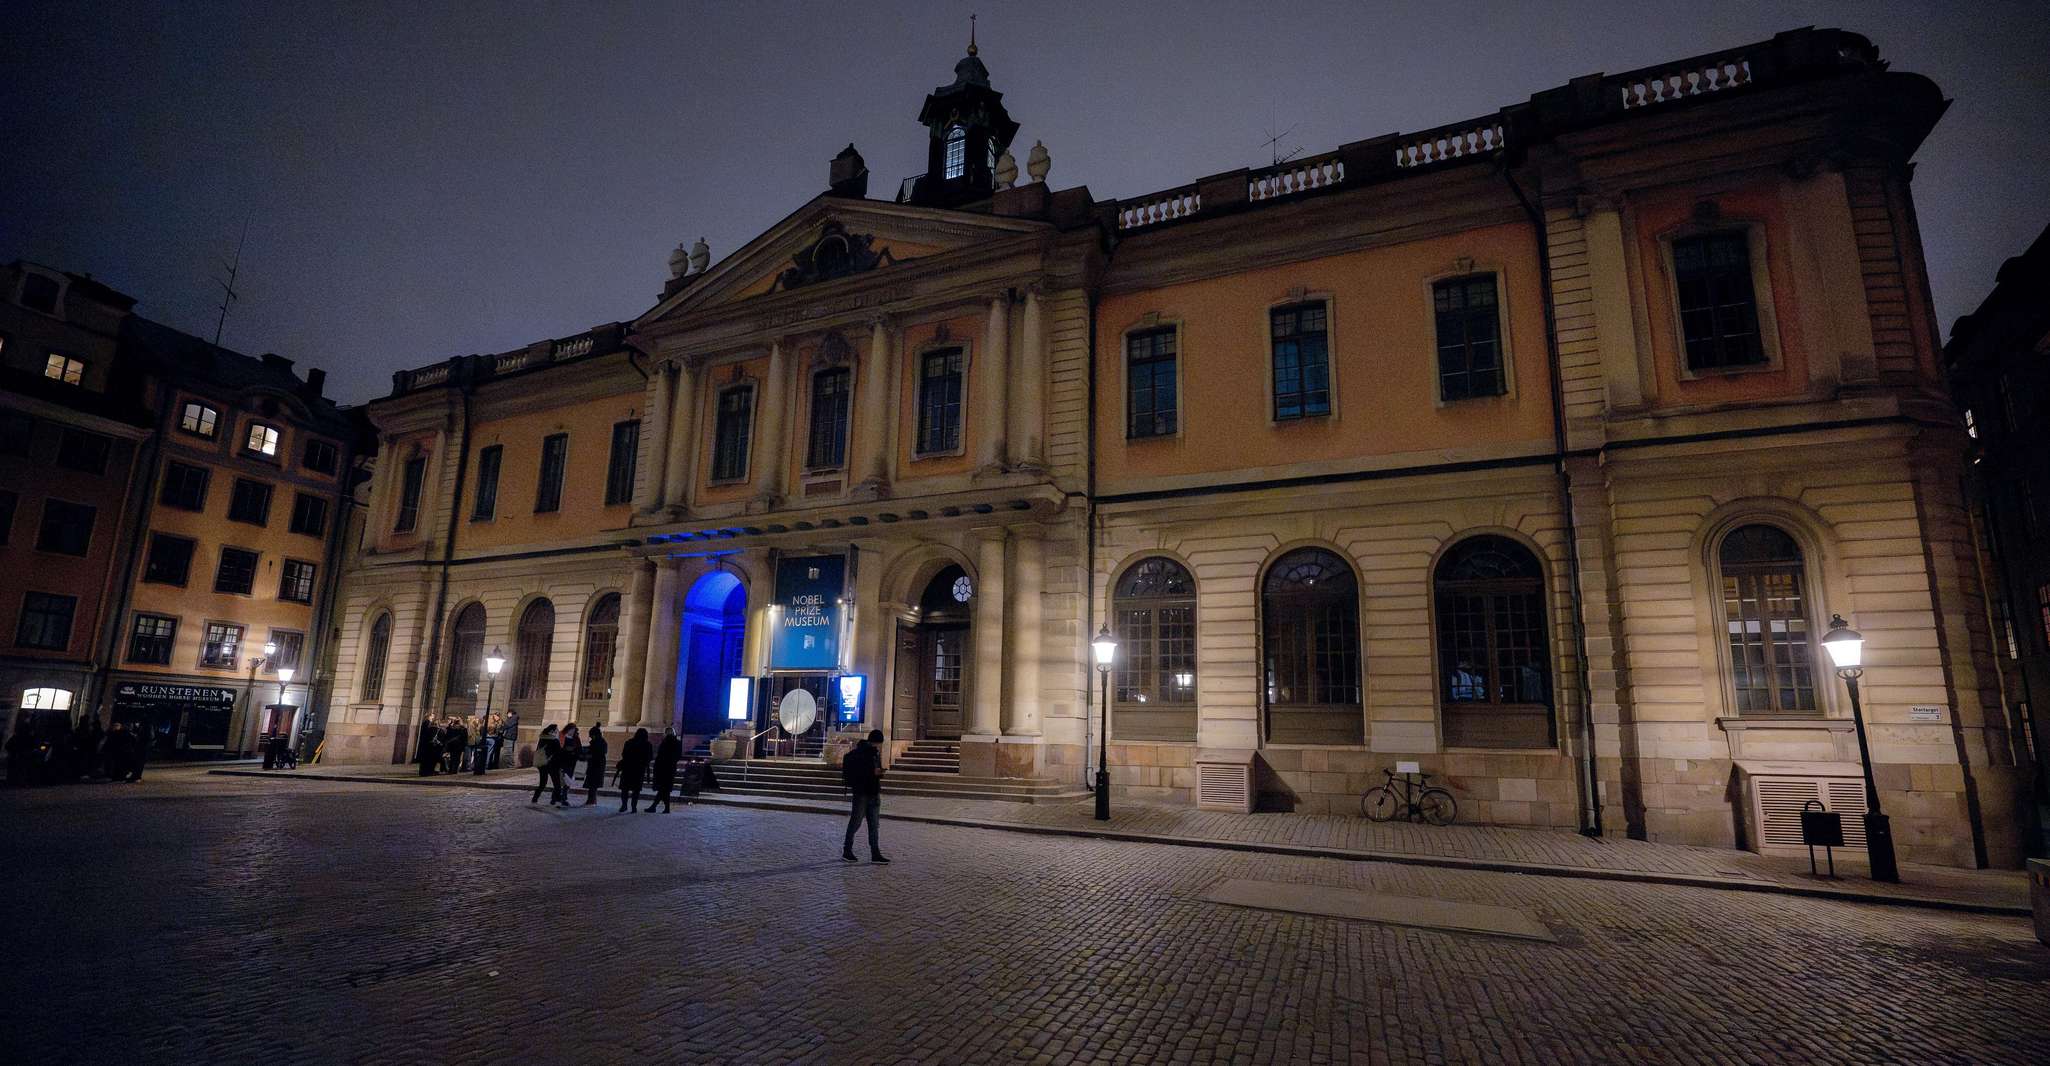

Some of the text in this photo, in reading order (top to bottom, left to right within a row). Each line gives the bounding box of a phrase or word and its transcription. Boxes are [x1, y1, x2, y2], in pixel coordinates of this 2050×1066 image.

[792, 595, 824, 605] NOBEL
[795, 605, 821, 616] PRIZE
[784, 616, 830, 627] MUSEUM
[141, 685, 218, 697] RUNSTENEN
